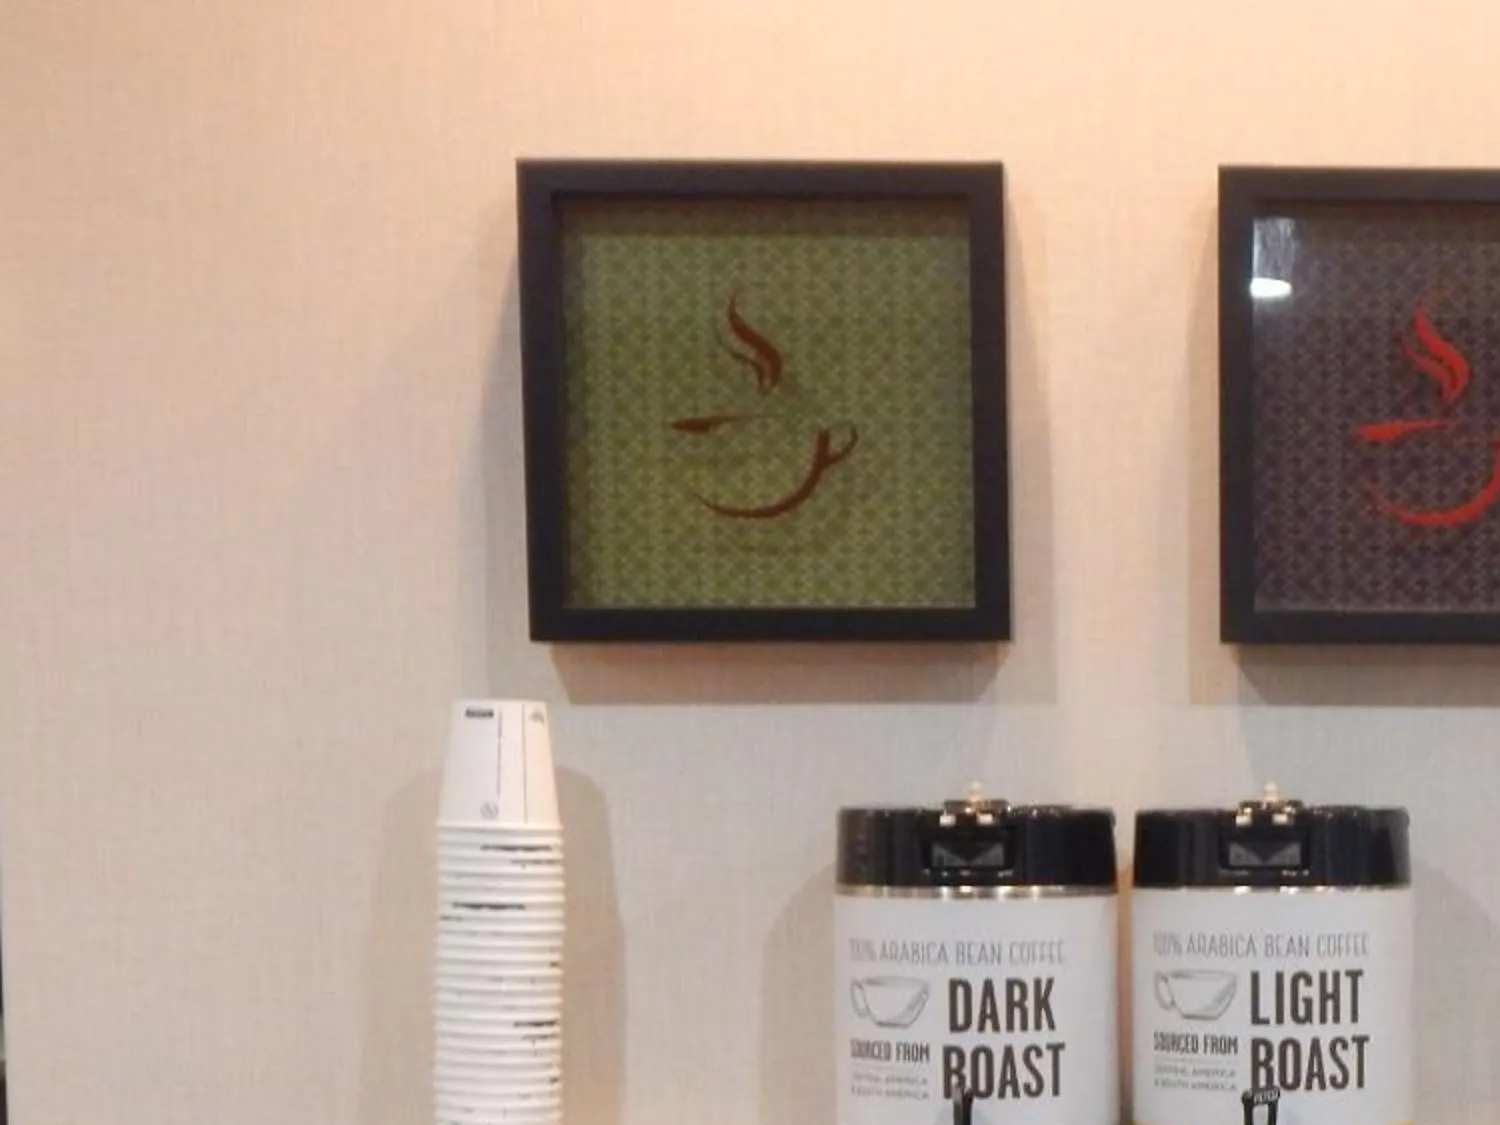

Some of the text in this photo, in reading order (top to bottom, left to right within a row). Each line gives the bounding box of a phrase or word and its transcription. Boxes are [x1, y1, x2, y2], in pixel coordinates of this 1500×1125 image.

[880, 940, 949, 966] ARABICA
[955, 941, 1001, 966] BEAN
[1009, 939, 1064, 966] COFFEE
[1186, 933, 1256, 959] ARABICA
[1264, 934, 1310, 959] BEAN
[1317, 933, 1369, 959] COFFEE
[949, 976, 1056, 1034] DARK
[1250, 969, 1364, 1026] LIGHT
[896, 1040, 930, 1064] FROM
[1153, 1031, 1239, 1055] SOURCED FROM
[1250, 1035, 1370, 1092] ROAST
[943, 1042, 1066, 1100] ROAST
